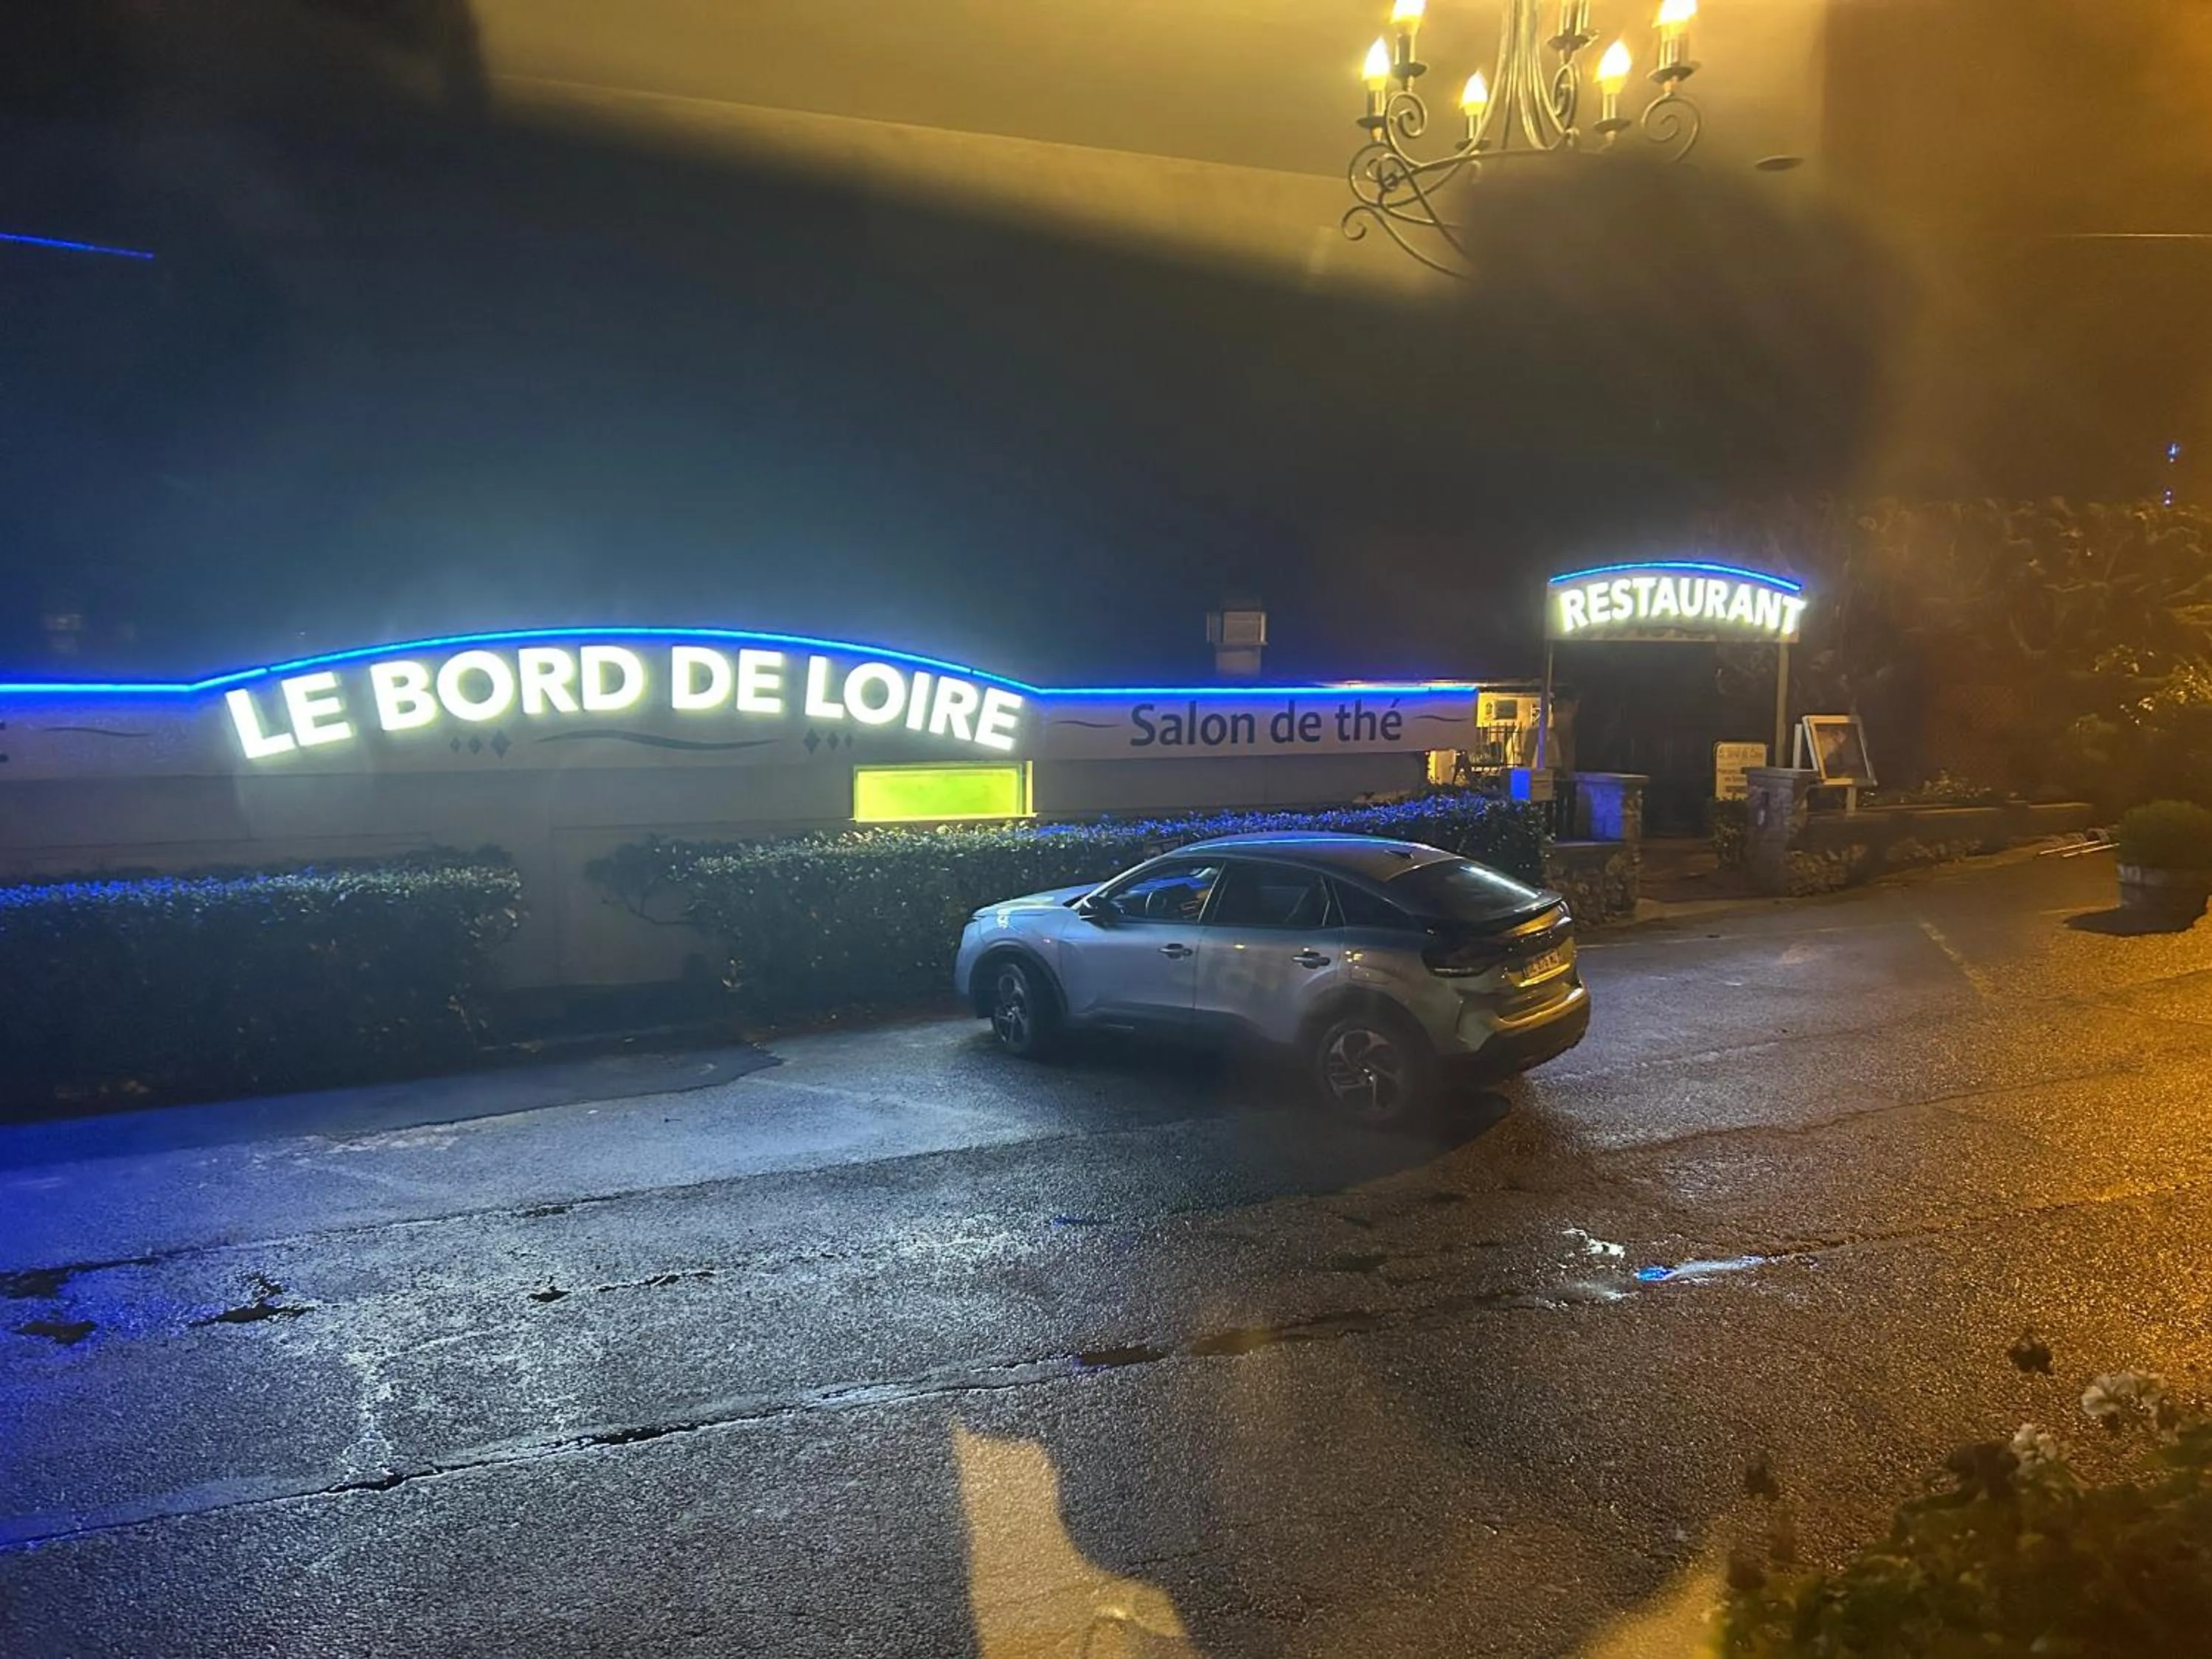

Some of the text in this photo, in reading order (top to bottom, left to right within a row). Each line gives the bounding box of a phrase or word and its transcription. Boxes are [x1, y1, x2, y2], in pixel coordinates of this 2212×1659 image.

[1560, 577, 1806, 635] RESTAURANT
[225, 645, 1023, 759] LE BORD DE LOIRE
[1130, 698, 1402, 747] Salon de thé
